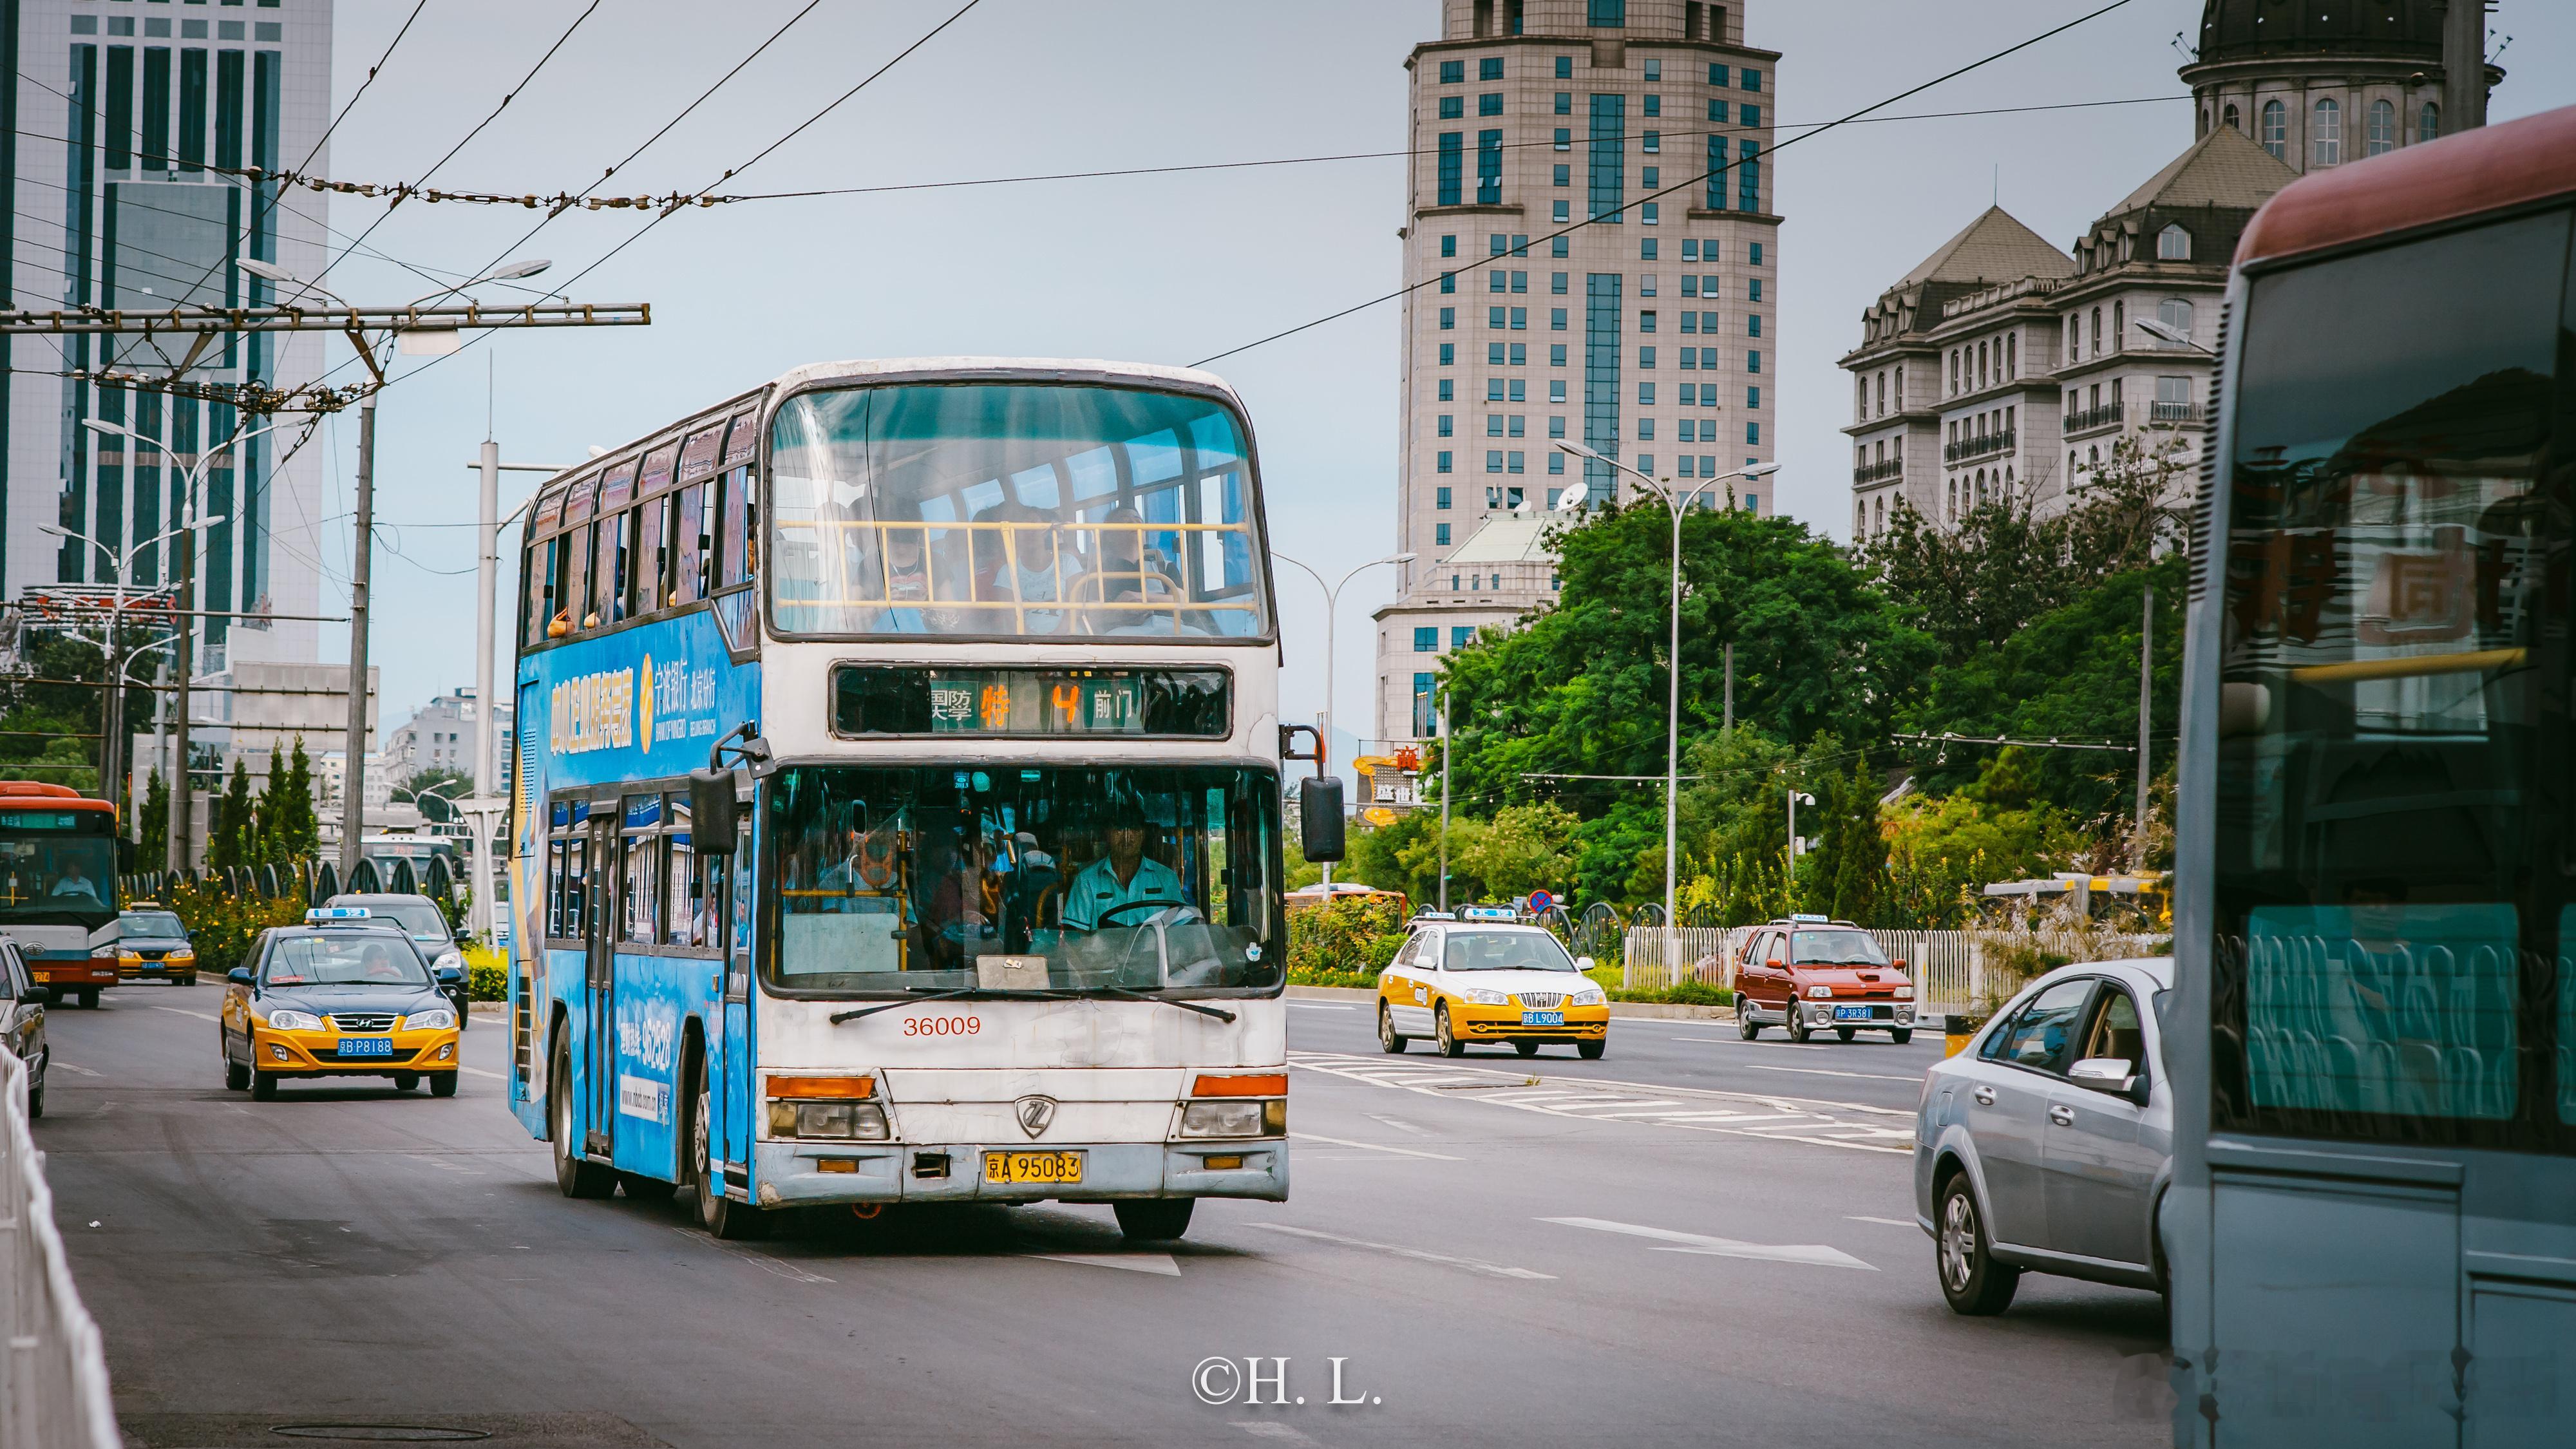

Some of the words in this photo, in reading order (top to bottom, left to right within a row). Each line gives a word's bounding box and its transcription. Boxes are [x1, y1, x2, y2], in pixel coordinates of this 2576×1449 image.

[655, 658, 688, 716] 宁波银行
[690, 667, 715, 710] 北京分行
[931, 690, 972, 706] 国防
[1094, 689, 1132, 719] 前门
[551, 666, 634, 757] 中小企业服务专家
[931, 706, 972, 721] 大学
[981, 684, 1010, 727] 特
[1052, 684, 1079, 724] 4
[904, 1016, 981, 1036] 36009
[642, 1018, 670, 1072] 962528
